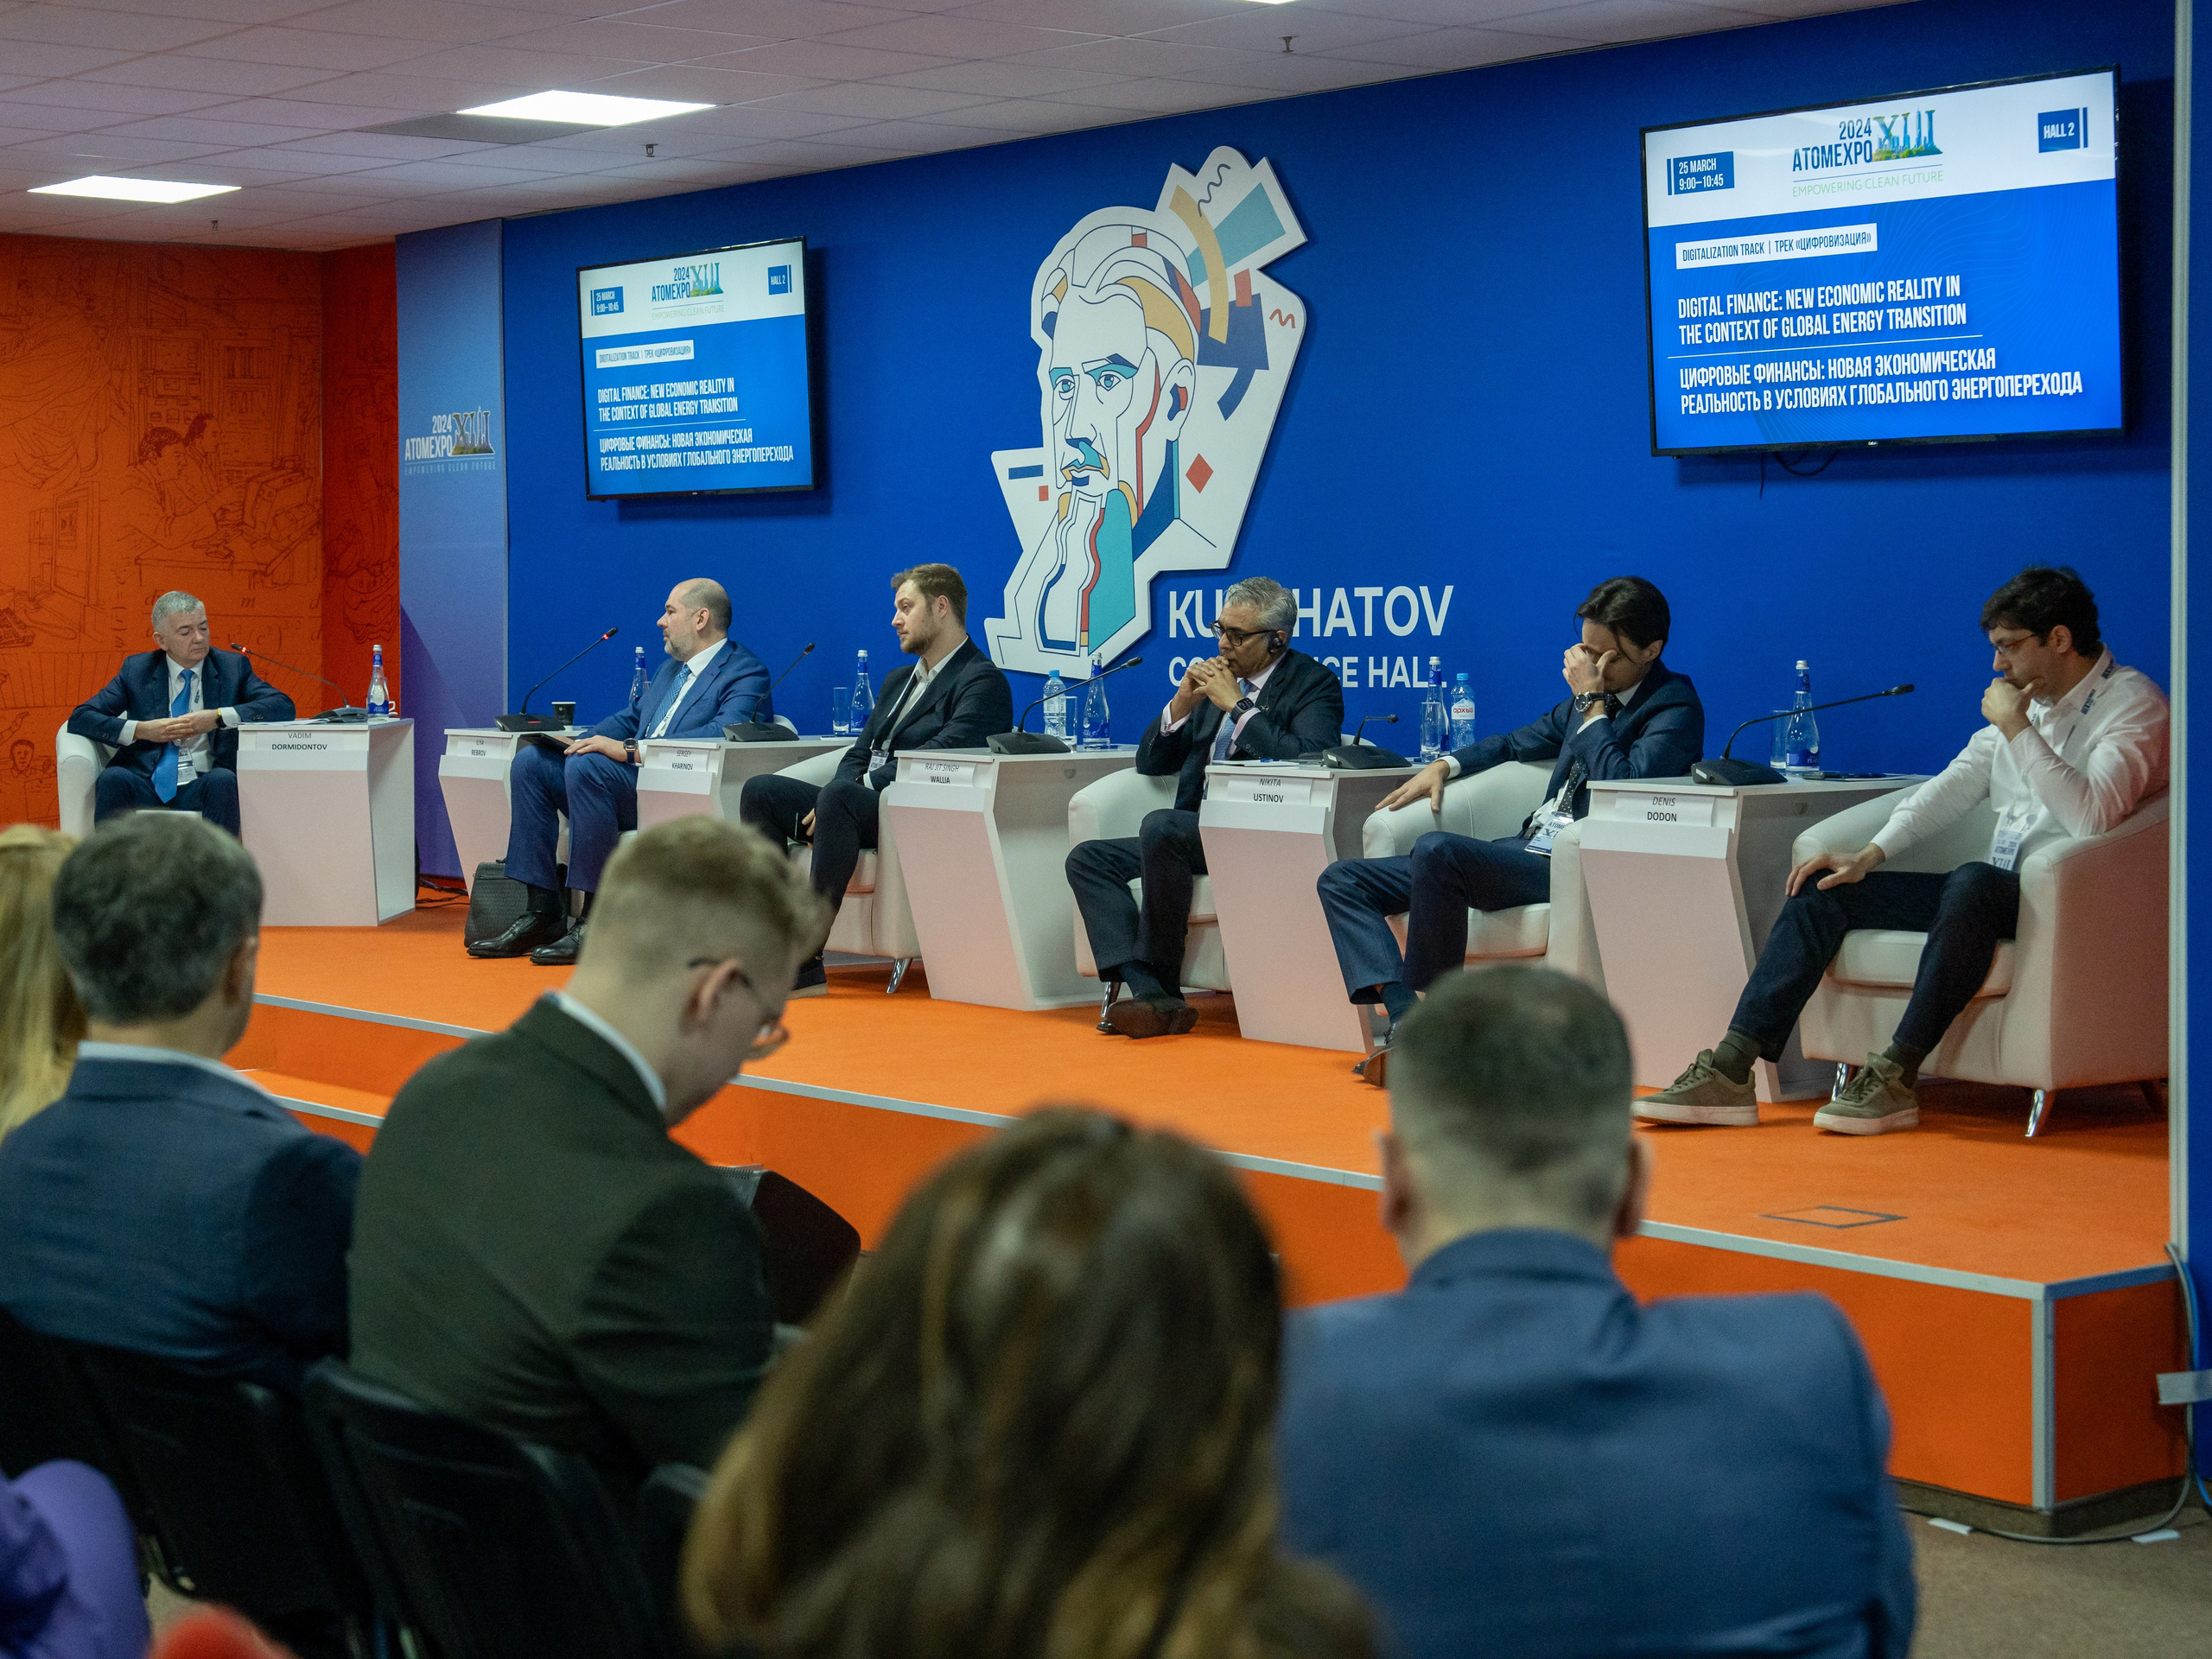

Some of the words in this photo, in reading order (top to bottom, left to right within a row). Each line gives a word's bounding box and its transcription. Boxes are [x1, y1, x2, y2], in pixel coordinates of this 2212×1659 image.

[1839, 118, 1872, 140] 2024
[2044, 123, 2067, 139] HALL
[2068, 122, 2075, 136] 2
[1679, 162, 1688, 174] 25
[1690, 158, 1716, 173] MARCH
[1792, 140, 1872, 172] ATOMEXPO
[1792, 181, 1863, 197] EMPOWERING
[1865, 176, 1899, 189] CLEAN
[1903, 170, 1944, 185] FUTURE
[1683, 245, 1738, 261] DIGITALIZATION
[1740, 240, 1764, 256] TRACK
[1775, 238, 1794, 252] ТРЕК
[1796, 232, 1872, 251] «ЦИФРОВИЗАЦИЯ»
[674, 266, 690, 281] 2024
[771, 276, 781, 285] HALL
[782, 275, 785, 283] 2
[596, 292, 601, 301] 25
[601, 290, 615, 300] MARCH
[652, 282, 690, 302] ATOMEXPO
[1678, 296, 1724, 318] DIGITAL
[1727, 290, 1782, 315] FINANCE:
[1786, 288, 1815, 309] NEW
[1818, 282, 1884, 308] ECONOMIC
[1887, 276, 1942, 302] REALITY
[1946, 275, 1960, 296] IN
[652, 309, 686, 320] EMPOWERING
[687, 308, 703, 316] CLEAN
[705, 304, 724, 315] FUTURE
[1679, 324, 1702, 345] THE
[1705, 320, 1761, 343] CONTEXT
[1763, 318, 1778, 339] OF
[1782, 315, 1830, 338] GLOBAL
[1834, 309, 1884, 334] ENERGY
[1887, 303, 1967, 329] TRANSITION
[600, 353, 627, 363] DIGITALIZATION
[628, 351, 639, 359] TRACK
[645, 349, 654, 358] ТРЕК
[1680, 365, 1751, 391] ЦИФРОВЫЕ
[1754, 359, 1825, 384] ФИНАНСЫ:
[1828, 356, 1872, 379] НОВАЯ
[1875, 347, 1996, 377] ЭКОНОМИЧЕСКАЯ
[598, 387, 620, 403] DIGITAL
[622, 385, 650, 402] FINANCE:
[651, 384, 664, 399] NEW
[666, 381, 698, 397] ECONOMIC
[700, 378, 726, 394] REALITY
[728, 378, 734, 392] IN
[1681, 391, 1761, 415] РЕАЛЬНОСТЬ
[1764, 391, 1771, 410] В
[1775, 385, 1847, 410] УСЛОВИЯХ
[1849, 379, 1948, 405] ГЛОБАЛЬНОГО
[1952, 372, 2082, 399] ЭНЕРГОПЕРЕХОДА
[599, 408, 610, 422] THE
[612, 404, 639, 421] CONTEXT
[640, 404, 647, 418] OF
[650, 403, 672, 418] GLOBAL
[674, 400, 698, 416] ENERGY
[699, 397, 738, 414] TRANSITION
[432, 415, 452, 434] 2024
[405, 435, 452, 461] ATOMEXPO
[600, 436, 635, 454] ЦИФРОВЫЕ
[636, 434, 671, 450] ФИНАНСЫ:
[672, 432, 693, 448] НОВАЯ
[695, 429, 753, 447] ЭКОНОМИЧЕСКАЯ
[601, 455, 640, 471] РЕАЛЬНОСТЬ
[641, 454, 645, 468] В
[647, 453, 683, 468] УСЛОВИЯХ
[683, 449, 731, 467] ГЛОБАЛЬНОГО
[732, 446, 793, 463] ЭНЕРГОПЕРЕХОДА
[1170, 586, 1453, 638] KUHATOV
[1369, 657, 1446, 688] HAL
[672, 762, 693, 771] KHARINOV
[1254, 793, 1284, 803] USTINOV
[1652, 797, 1675, 807] DENIS
[1647, 812, 1676, 822] DODON
